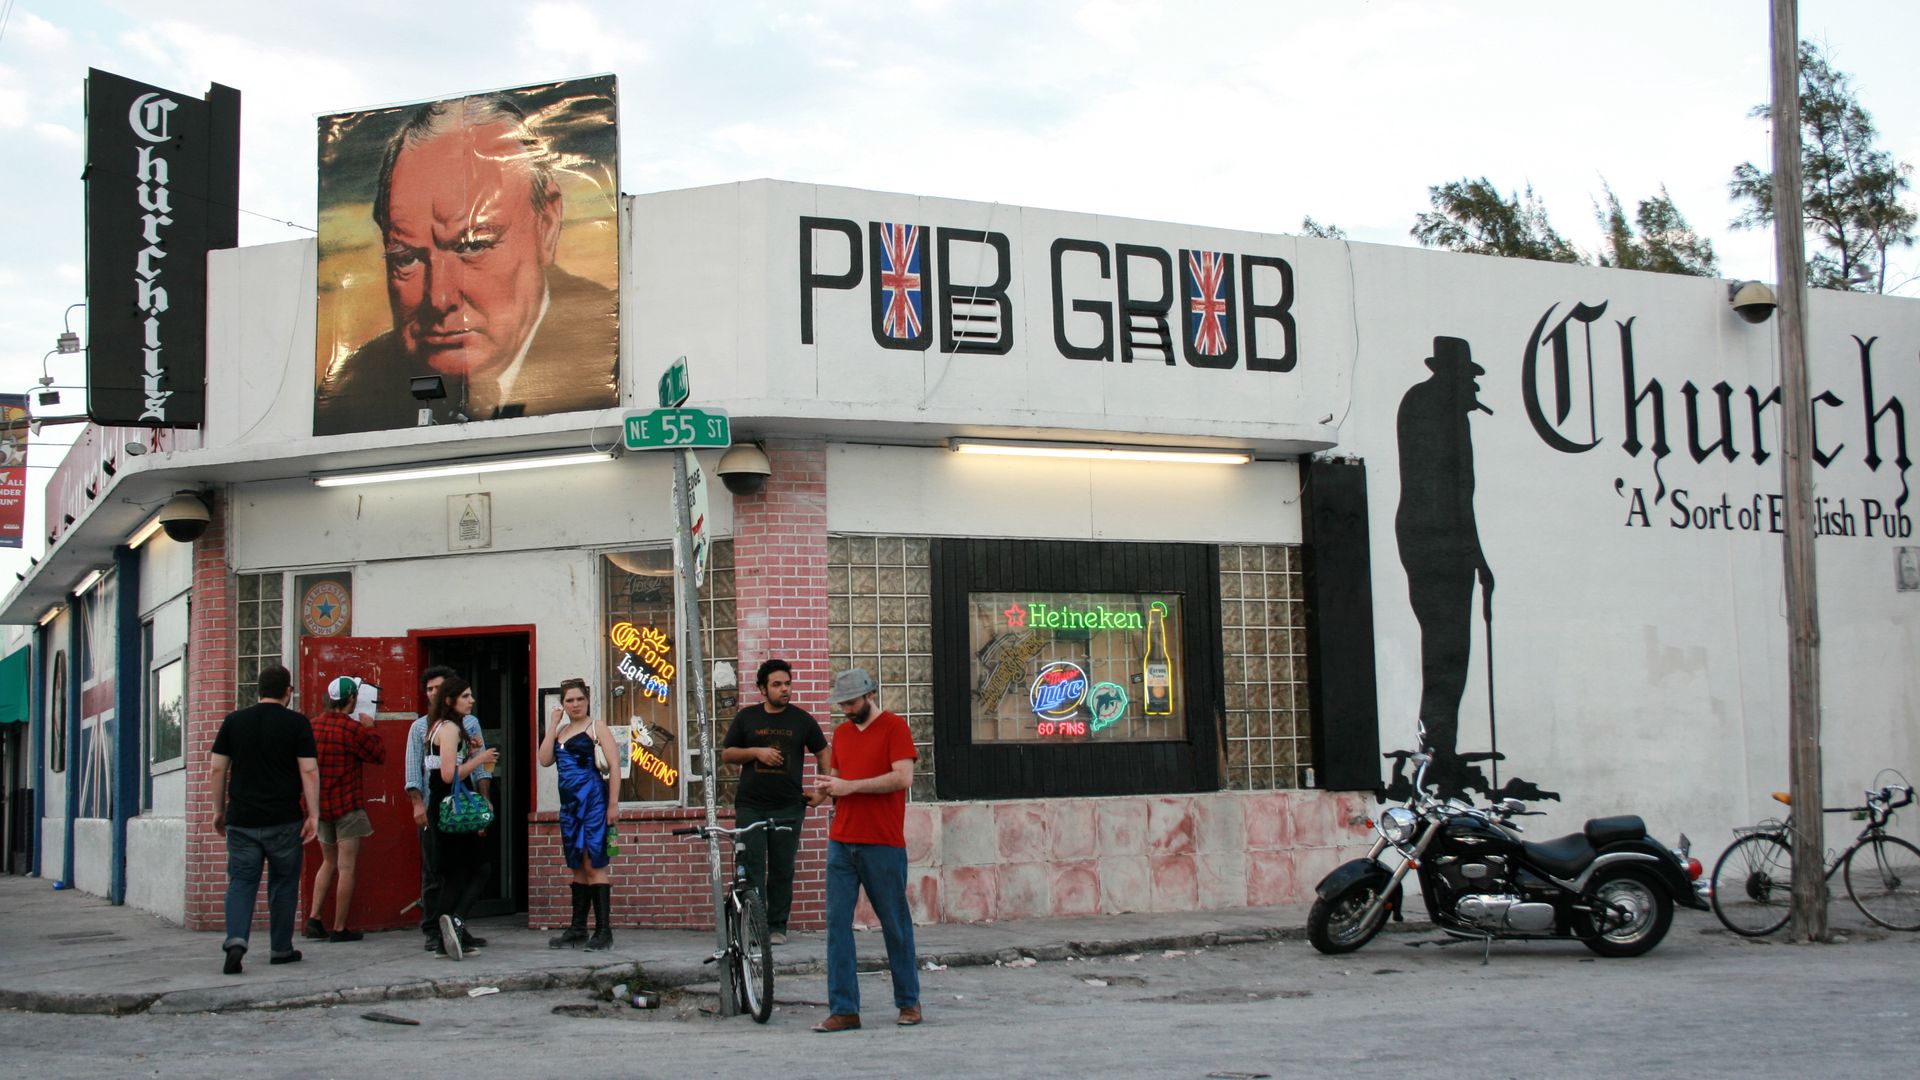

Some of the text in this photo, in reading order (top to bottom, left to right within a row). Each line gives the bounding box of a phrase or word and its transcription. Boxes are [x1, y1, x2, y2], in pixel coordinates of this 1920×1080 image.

[799, 215, 1297, 373] PUB GRUB
[630, 415, 722, 444] NE 55 ST
[1670, 488, 1735, 531] Sort
[1738, 493, 1761, 531] of
[1767, 494, 1857, 537] Elish
[1860, 498, 1912, 539] Pub
[1028, 603, 1143, 629] Heineken
[611, 622, 675, 680] Corona
[617, 652, 651, 684] Light
[1037, 722, 1086, 736] GO FINS
